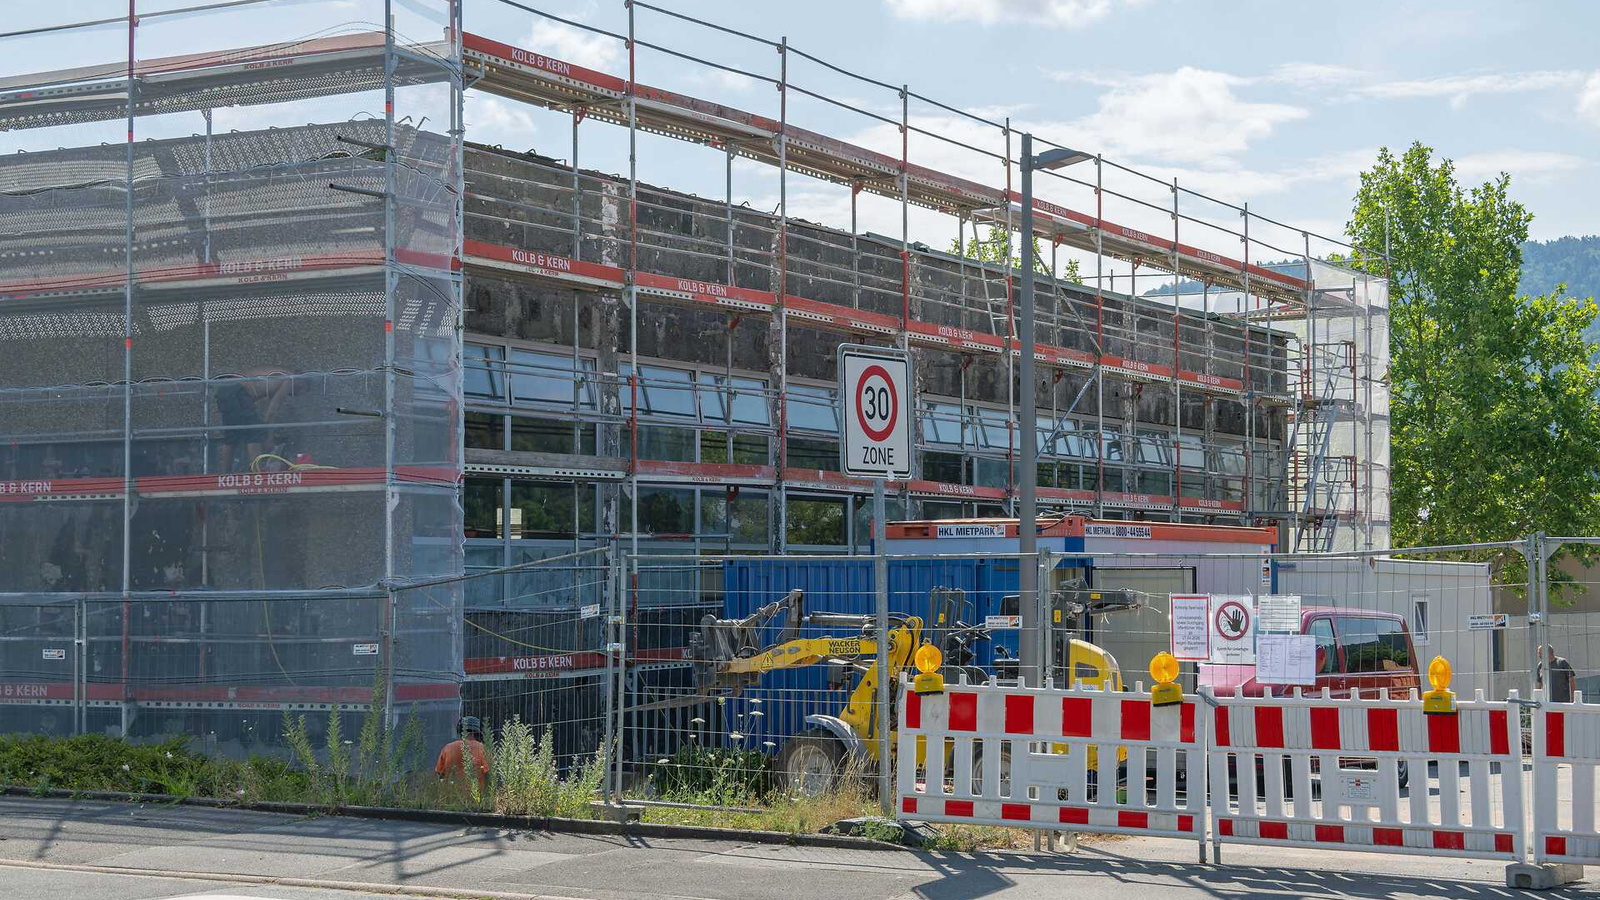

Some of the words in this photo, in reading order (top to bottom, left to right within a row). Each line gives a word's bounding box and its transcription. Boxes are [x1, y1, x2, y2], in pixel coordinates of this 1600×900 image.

[511, 48, 535, 65] KOLB
[537, 56, 544, 67] &
[546, 58, 570, 76] KERN
[1036, 199, 1049, 212] KOLB
[1054, 205, 1067, 217] KERN
[512, 249, 536, 265] KOLB
[538, 254, 545, 266] &
[546, 256, 570, 271] KERN
[678, 279, 698, 293] KOLB
[698, 283, 705, 294] &
[706, 284, 727, 297] KERN
[938, 325, 953, 337] KOLB
[958, 330, 973, 341] KERN
[865, 385, 889, 421] 30
[862, 446, 894, 466] ZONE
[20, 480, 52, 494] KERN
[218, 475, 251, 487] KOLB
[267, 472, 302, 485] KERN
[938, 482, 953, 494] KOLB
[959, 484, 974, 496] KERN
[938, 527, 953, 536] HKL
[956, 527, 996, 536] MIETPARK
[828, 640, 861, 648] WACKER
[513, 658, 537, 670] KOLB
[548, 655, 572, 668] KERN
[16, 684, 48, 697] KERN
